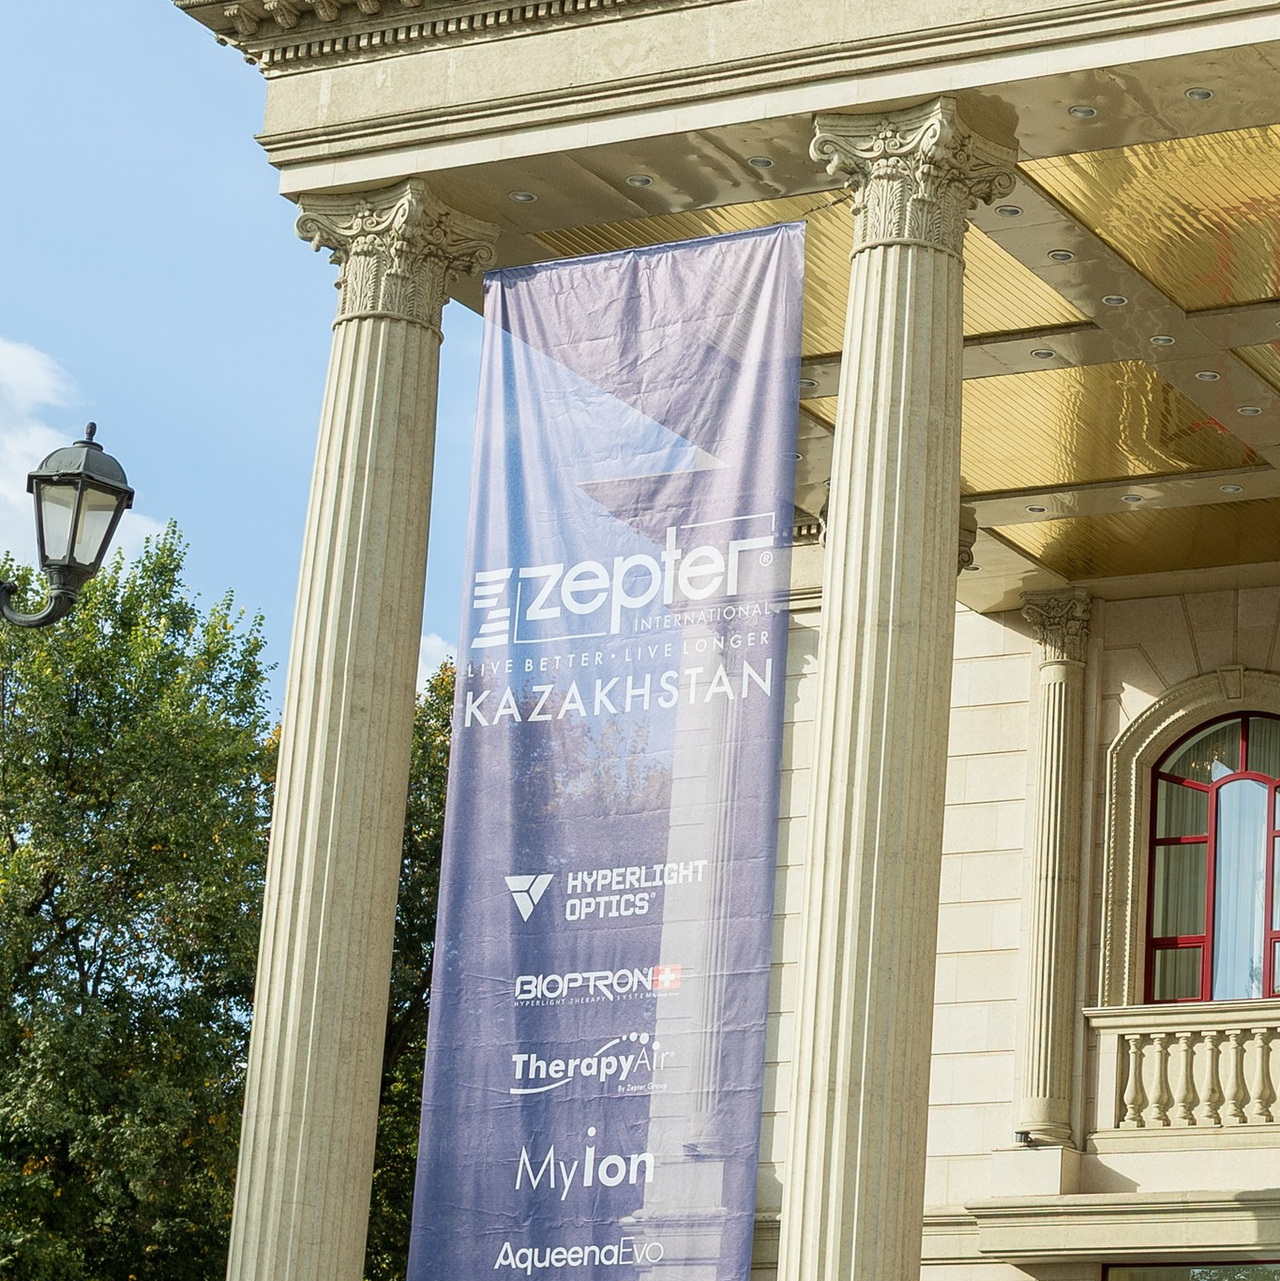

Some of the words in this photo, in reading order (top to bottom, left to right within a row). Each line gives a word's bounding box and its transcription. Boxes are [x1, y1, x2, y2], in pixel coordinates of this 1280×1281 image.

[518, 526, 775, 635] zepter
[634, 602, 771, 632] INTERNATIONAL
[467, 658, 513, 678] LIVE
[525, 652, 604, 672] BETTER
[625, 643, 673, 662] LIVE
[684, 631, 770, 655] LONGER
[464, 658, 773, 728] KAZAKHSTAN
[567, 859, 708, 894] HYPERLIGHT
[513, 999, 565, 1008] HYPERLIGHT
[569, 996, 606, 1005] THERAPY
[514, 966, 654, 1002] BIOPTRON
